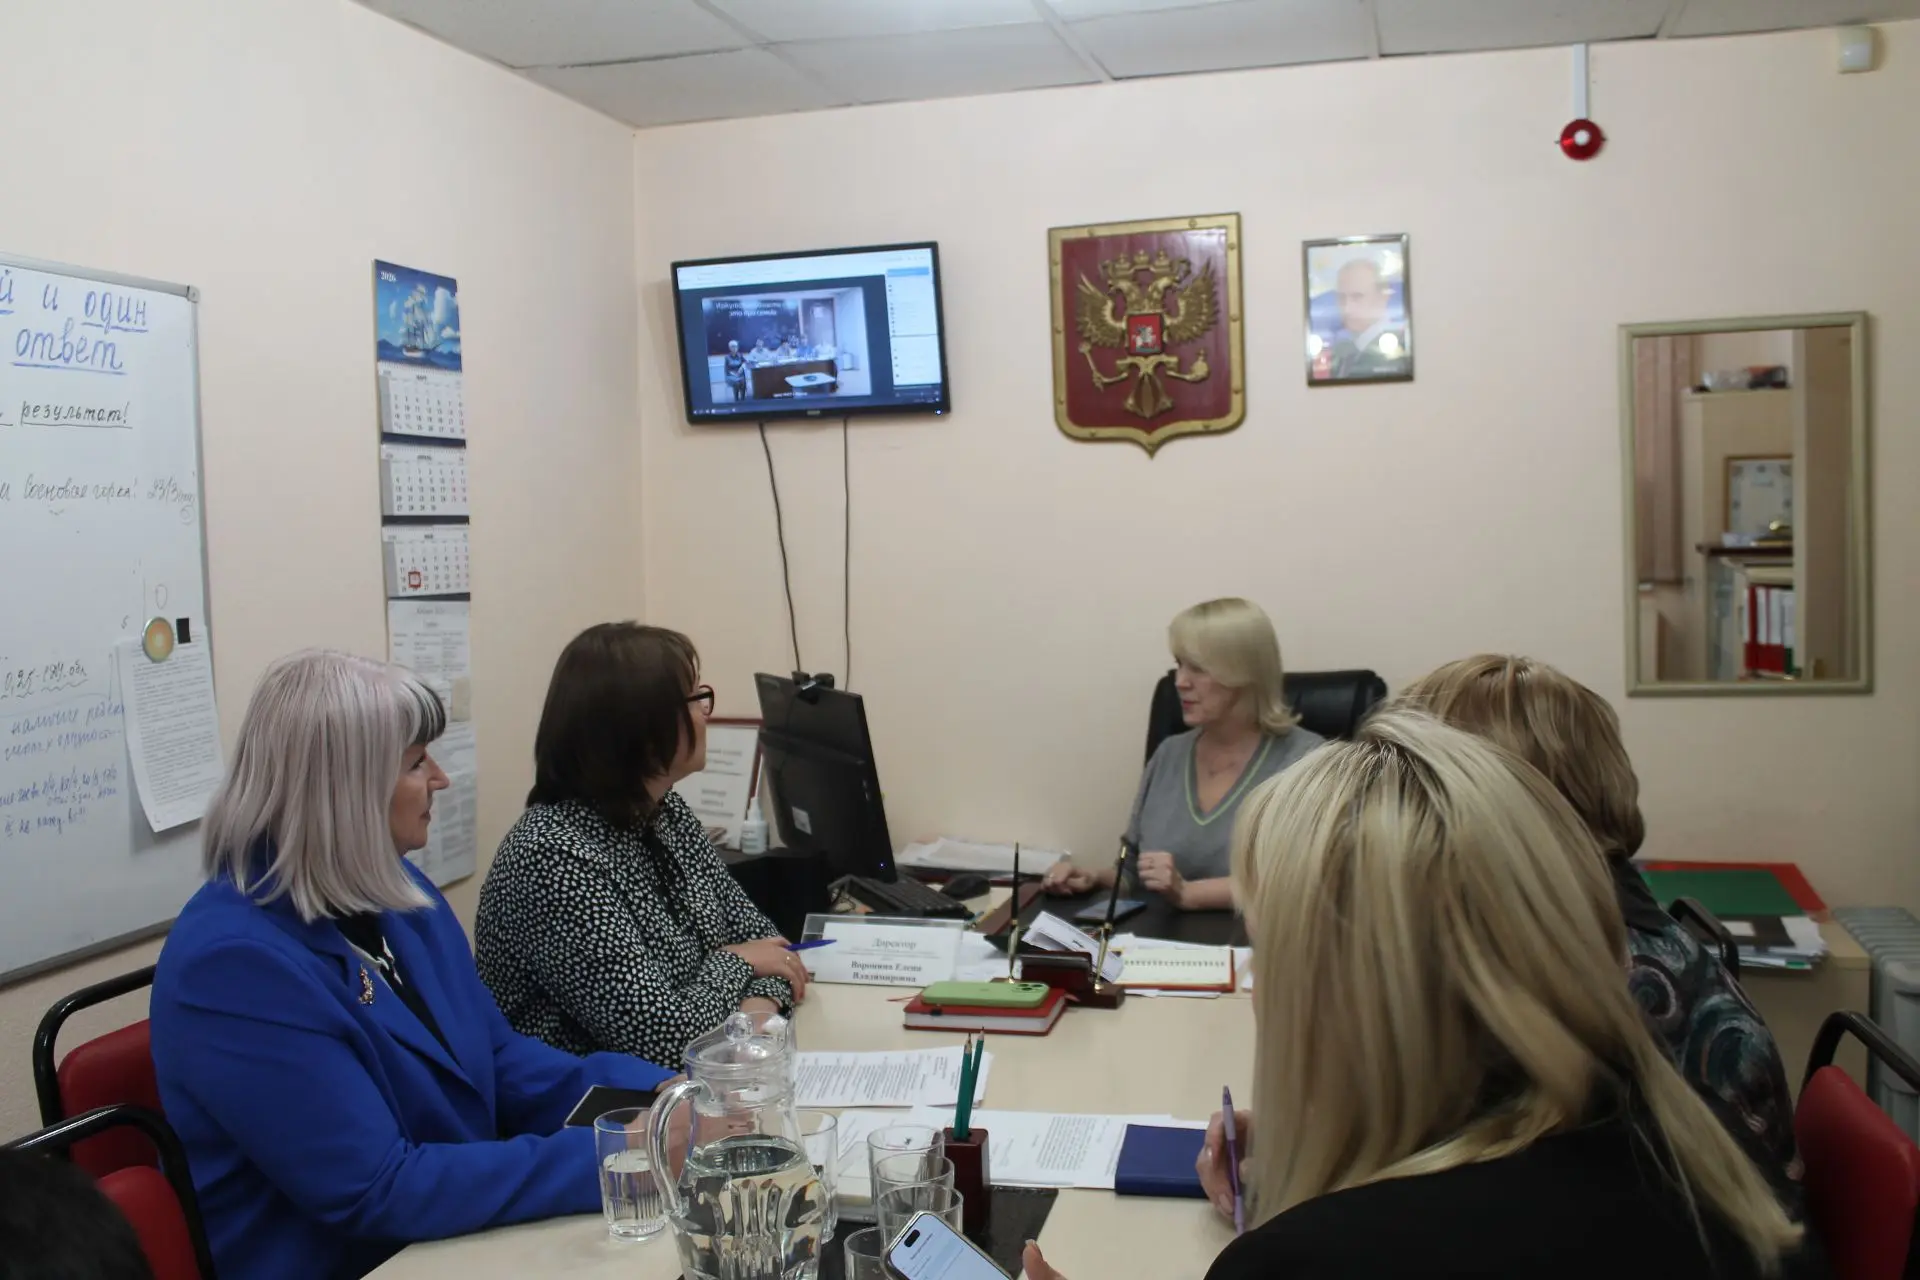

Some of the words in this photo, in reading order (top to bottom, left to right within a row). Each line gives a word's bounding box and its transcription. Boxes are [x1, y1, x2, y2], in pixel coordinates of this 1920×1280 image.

[42, 283, 59, 311] и
[84, 290, 147, 334] один
[15, 316, 123, 370] ответ
[21, 400, 130, 425] результат!
[871, 937, 917, 951] Директор
